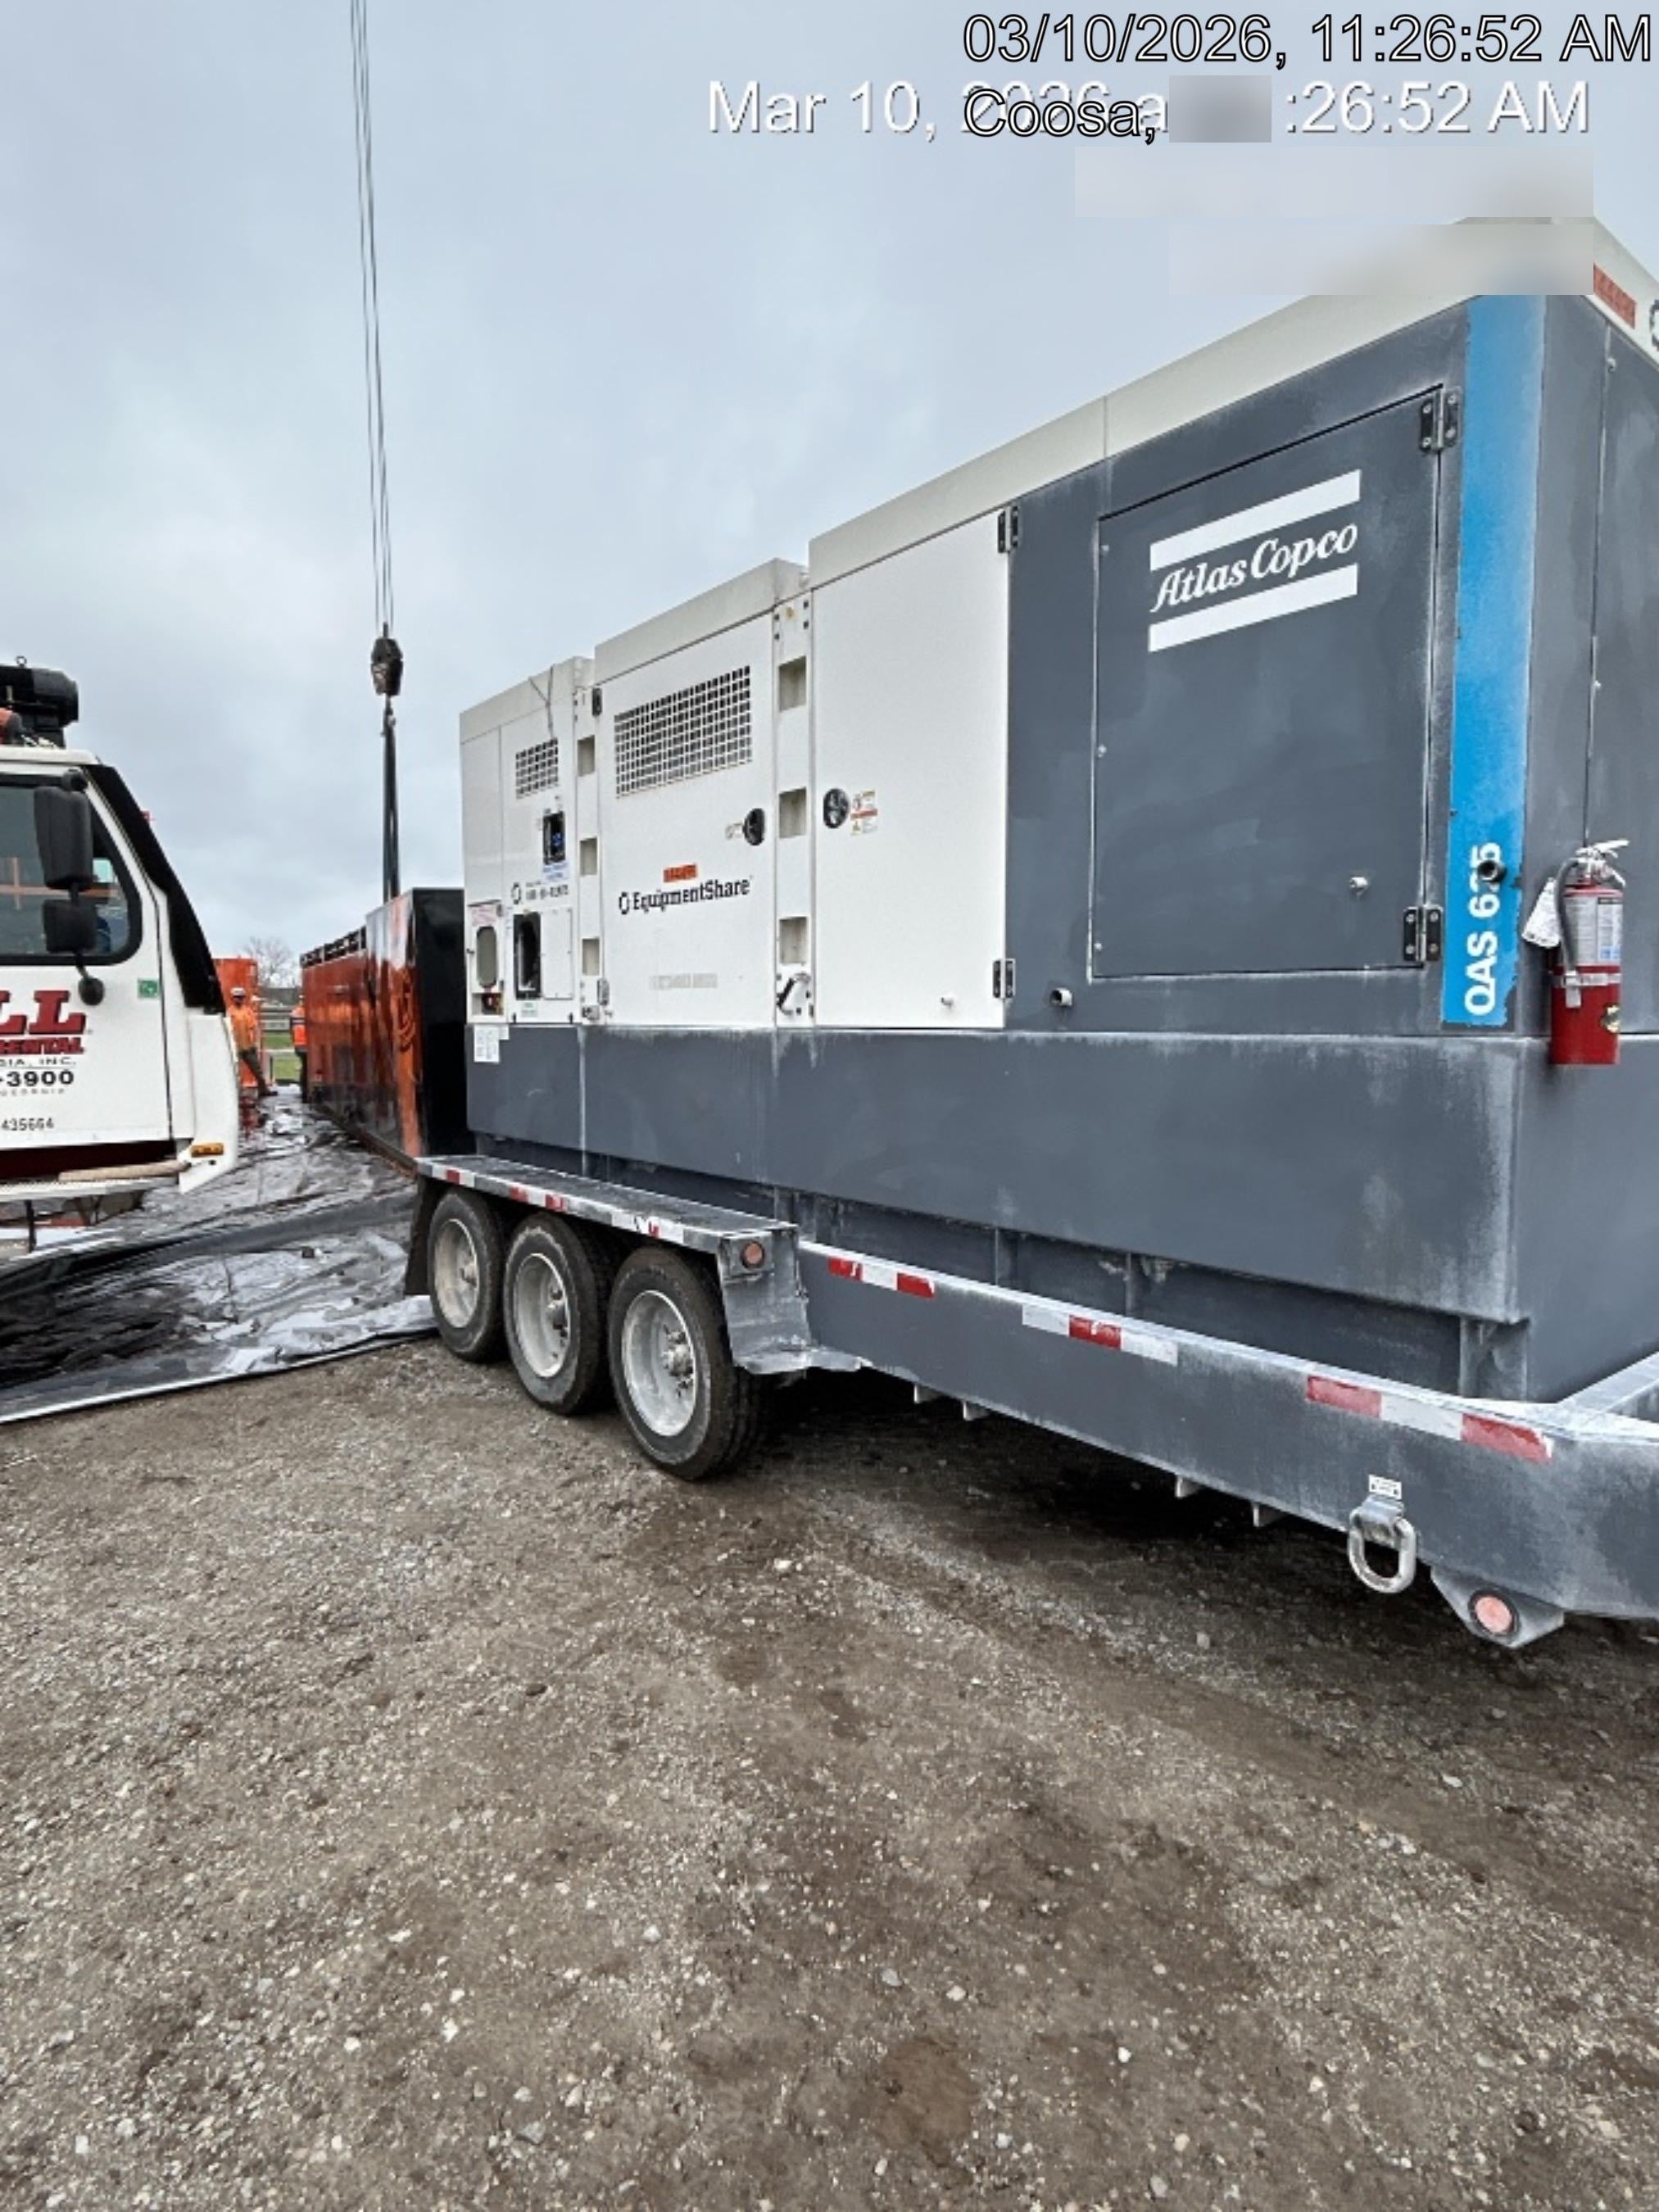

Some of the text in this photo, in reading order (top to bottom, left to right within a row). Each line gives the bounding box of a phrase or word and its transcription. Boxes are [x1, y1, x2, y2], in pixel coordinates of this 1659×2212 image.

[1149, 523, 1358, 613] Atlas Copco
[632, 878, 750, 913] EquipmentShare
[1464, 930, 1499, 1017] QAS
